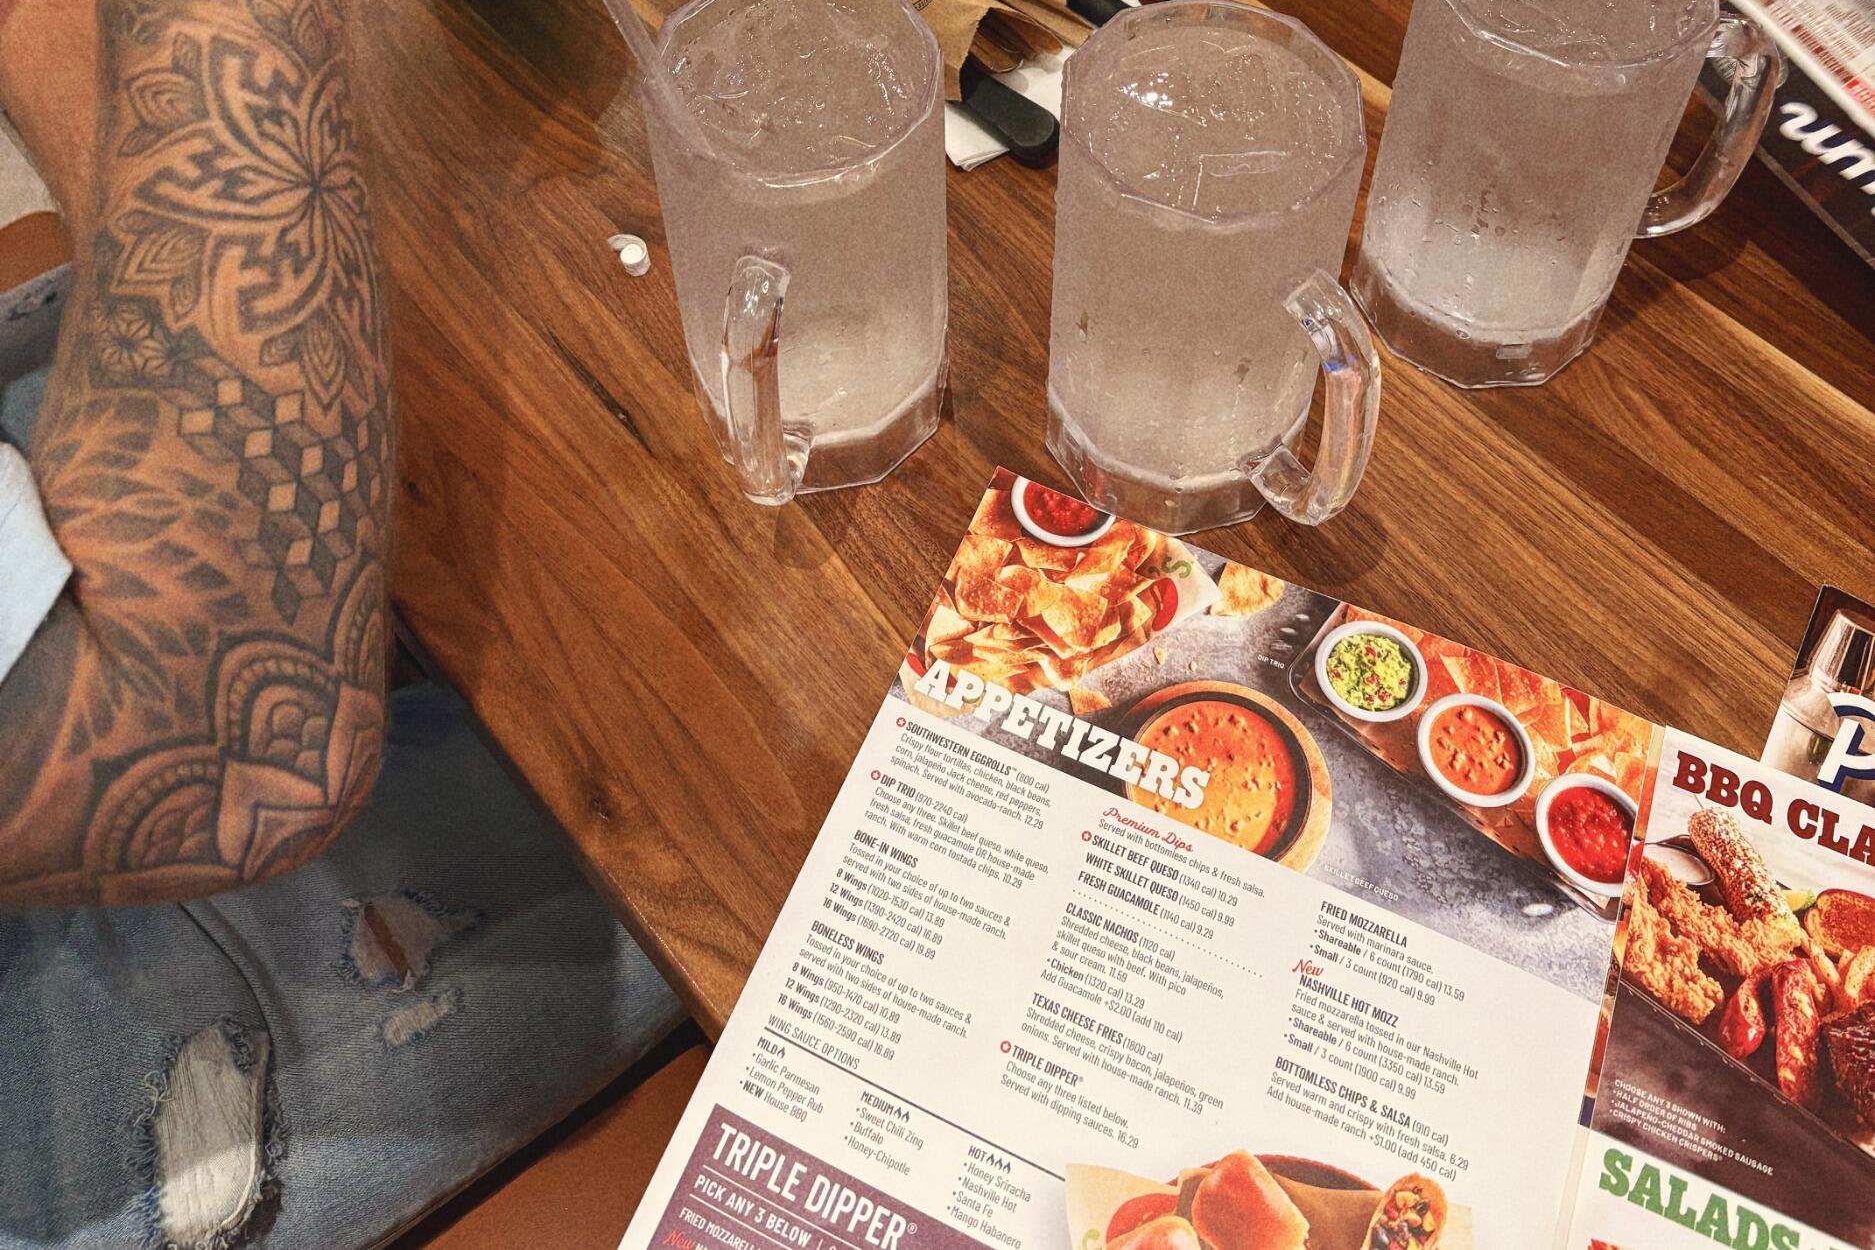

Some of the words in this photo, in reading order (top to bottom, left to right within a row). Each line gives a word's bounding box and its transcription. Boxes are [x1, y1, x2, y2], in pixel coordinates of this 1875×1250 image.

[1257, 653, 1269, 665] DIP
[1269, 656, 1285, 669] TRIO
[914, 658, 1210, 810] APPETIZERS
[905, 721, 970, 757] SOUTHWESTERN
[1015, 771, 1034, 786] (800
[1034, 781, 1050, 793] cal)
[880, 773, 896, 787] DIP
[896, 781, 916, 798] TRIO
[914, 791, 953, 815] (970-2240
[952, 811, 968, 824] cal)
[1672, 750, 1773, 825] BBQ
[853, 829, 889, 854] BONE-IN
[889, 846, 918, 868] WINGS
[1103, 807, 1160, 837] Premium
[1161, 831, 1193, 852] Dips
[1085, 852, 1114, 873] WHITE
[1113, 865, 1149, 888] SKILLET
[1149, 880, 1178, 901] QUESO
[1178, 894, 1200, 911] (1450
[1200, 907, 1217, 920] cal)
[1216, 911, 1234, 927] 9.99
[1091, 834, 1127, 857] SKILLET
[1126, 849, 1149, 866] BEEF
[1149, 859, 1179, 880] QUESO
[1178, 873, 1200, 890] (1340
[1201, 885, 1217, 898] cal)
[1217, 890, 1238, 906] 10.29
[1373, 884, 1399, 901] QUESO
[829, 882, 839, 894] 12
[839, 887, 863, 906] Wings
[863, 899, 906, 927] (1390-2420
[906, 922, 923, 937] cal)
[922, 928, 943, 945] 16.89
[836, 867, 843, 877] 8
[843, 871, 867, 890] Wings
[867, 883, 909, 910] (1020-1530
[908, 906, 925, 919] cal)
[924, 911, 945, 928] 13.89
[1077, 870, 1107, 891] FRESH
[1107, 883, 1160, 915] GUACAMOLE
[1159, 907, 1179, 924] (1140
[1180, 919, 1196, 933] cal)
[1196, 924, 1213, 939] 9.29
[811, 920, 855, 950] BONELESS
[855, 942, 884, 965] WINGS
[1065, 902, 1102, 926] CLASSIC
[1102, 919, 1139, 943] NACHOS
[1138, 936, 1158, 953] (1120
[1159, 948, 1175, 961] cal)
[1316, 914, 1346, 934] Served
[1347, 929, 1365, 943] with
[1366, 938, 1404, 960] marinara
[1406, 956, 1433, 974] sauce.
[1320, 900, 1347, 920] FRIED
[1348, 913, 1407, 947] MOZZARELLA
[1292, 959, 1324, 977] New
[1040, 968, 1057, 983] Add
[1057, 976, 1102, 1004] Guacamole
[1131, 1010, 1152, 1028] (add
[1152, 1020, 1165, 1034] 110
[1165, 1029, 1182, 1043] cal)
[1299, 974, 1350, 1005] NASHVILLE
[1350, 997, 1371, 1014] HOT
[1371, 1006, 1398, 1028] MOZZ
[756, 1036, 778, 1054] MILD
[768, 1013, 791, 1034] WING
[791, 1026, 821, 1050] SAUCE
[821, 1042, 860, 1069] OPTIONS
[1032, 992, 1060, 1014] TEXAS
[1060, 1006, 1096, 1032] CHEESE
[1095, 1023, 1123, 1044] FRIES
[1122, 1036, 1146, 1056] (1800
[1146, 1050, 1163, 1065] cal)
[755, 1053, 779, 1073] Garlic
[779, 1065, 820, 1094] Parmesan
[1012, 1044, 1044, 1070] TRIPLE
[742, 1080, 764, 1098] NEW
[763, 1091, 789, 1113] House
[789, 1104, 807, 1122] BBQ
[748, 1066, 776, 1089] Lemon
[776, 1081, 806, 1104] Pepper
[806, 1096, 823, 1113] Rub
[860, 1091, 894, 1115] MEDIUM
[1275, 1056, 1337, 1093] BOTTOMLESS
[1338, 1085, 1368, 1108] CHIPS
[1369, 1099, 1377, 1113] &
[1380, 1104, 1410, 1128] SALSA
[1411, 1119, 1430, 1137] (910
[1431, 1131, 1448, 1147] cal)
[1614, 1079, 1647, 1099] CHOOSE
[1647, 1091, 1665, 1106] ANY
[1671, 1102, 1701, 1122] SHOWN
[1702, 1114, 1726, 1134] WITH:
[1616, 1089, 1638, 1107] HALF
[1637, 1099, 1666, 1118] ORDER
[1666, 1109, 1678, 1121] OF
[1677, 1115, 1697, 1131] RIBS
[853, 1121, 883, 1144] Buffalo
[859, 1107, 885, 1128] Sweet
[885, 1120, 905, 1138] Chili
[904, 1129, 924, 1150] Zing
[1612, 1109, 1642, 1129] CRISPY
[1641, 1121, 1679, 1145] CHICKEN
[711, 1122, 808, 1201] TRIPLE
[847, 1136, 910, 1175] Honey-Chipotle
[967, 1145, 987, 1162] HOT
[1700, 1137, 1734, 1158] SMOKED
[1734, 1150, 1774, 1176] SAUSAGE
[956, 1190, 981, 1212] Santa
[981, 1203, 993, 1218] Fe
[961, 1176, 1000, 1204] Nashville
[1000, 1195, 1017, 1213] Hot
[967, 1162, 994, 1185] Honey
[994, 1175, 1031, 1202] Sriracha
[1599, 1148, 1800, 1250] SALADS
[678, 1207, 706, 1231] FRIED
[694, 1174, 726, 1203] PICK
[725, 1190, 753, 1217] ANY
[754, 1207, 764, 1223] 3
[765, 1213, 812, 1248] BELOW
[950, 1205, 979, 1228] Mango
[979, 1220, 1021, 1249] Habanero
